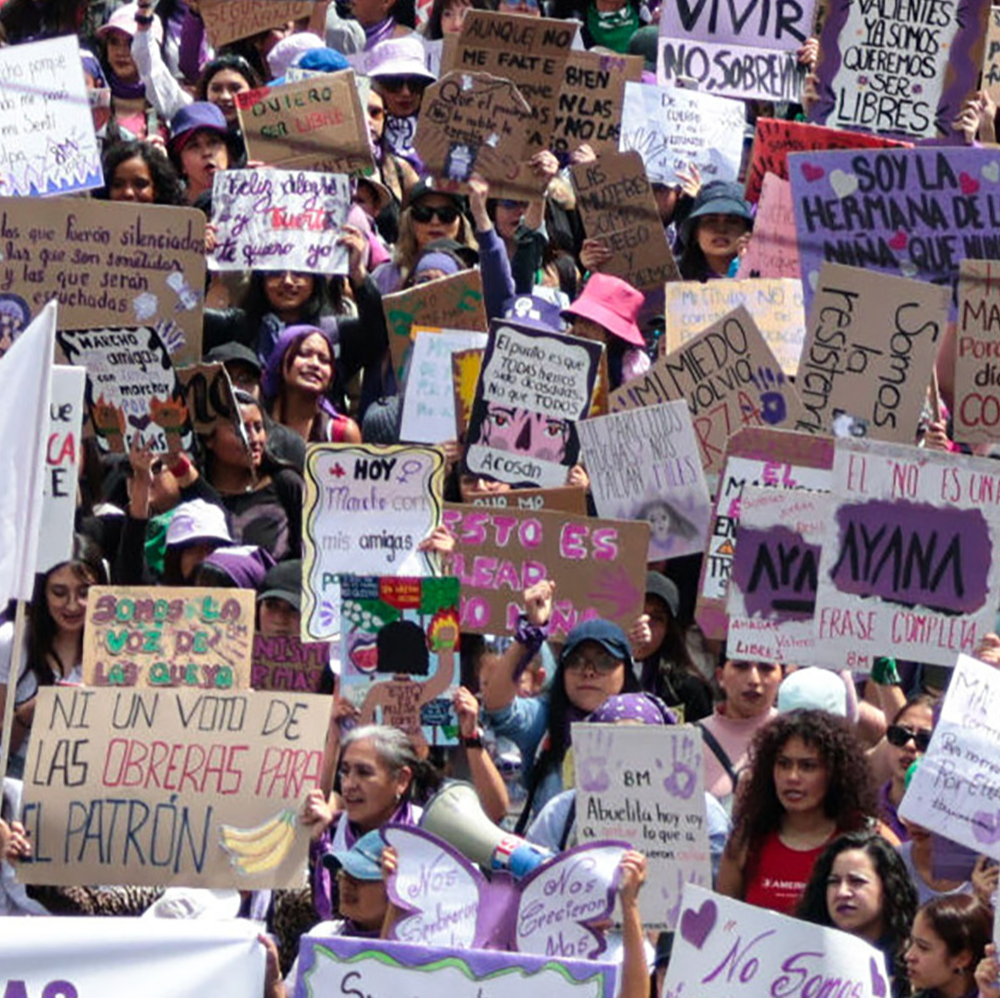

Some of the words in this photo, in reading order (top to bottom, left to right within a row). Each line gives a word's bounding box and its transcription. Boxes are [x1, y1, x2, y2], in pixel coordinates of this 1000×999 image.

[543, 26, 571, 47] NO
[865, 24, 888, 47] YA
[889, 24, 940, 55] SOMOS
[463, 50, 487, 64] ME
[843, 46, 936, 78] QUEREMOS
[868, 74, 910, 98] SER
[837, 87, 931, 131] LIBRES
[851, 155, 907, 192] SOY
[917, 153, 959, 189] LA
[803, 196, 946, 232] HERMANA
[354, 459, 397, 481] HOY
[481, 457, 542, 479] Acosan
[359, 530, 413, 562] amigas
[560, 522, 617, 560] ES
[818, 608, 876, 641] FRASE
[891, 613, 977, 649] COMPLETA
[49, 691, 95, 730] NI
[111, 693, 160, 730] UN
[175, 693, 248, 732] VOTO
[261, 699, 308, 741] DE
[32, 739, 89, 787] LAS
[101, 737, 249, 796] OBRERAS
[255, 747, 322, 798] PARA
[64, 794, 213, 875] PATRÓN
